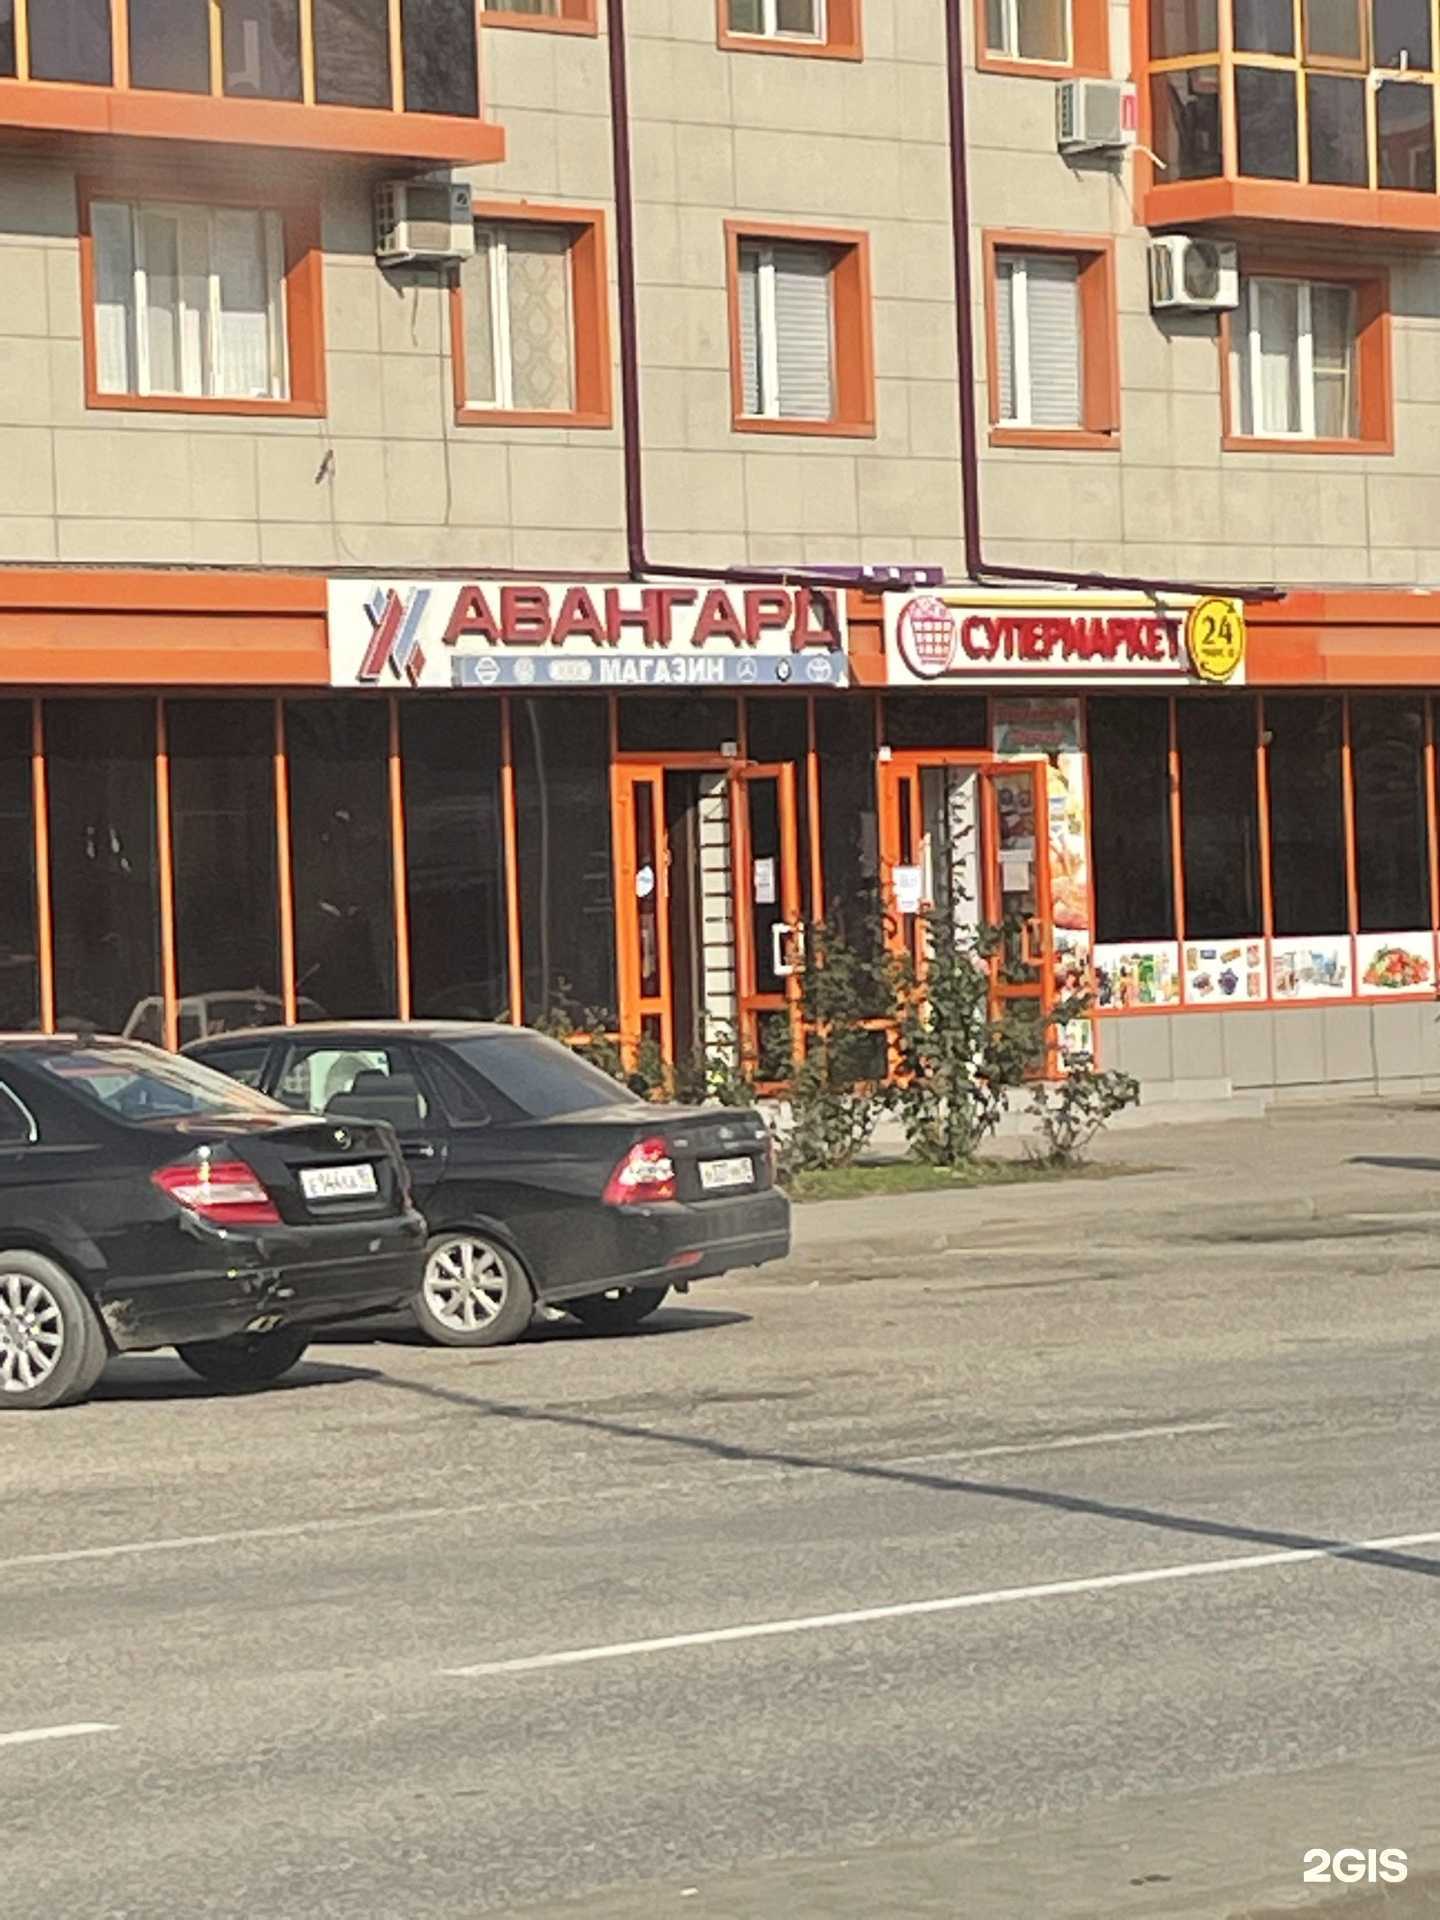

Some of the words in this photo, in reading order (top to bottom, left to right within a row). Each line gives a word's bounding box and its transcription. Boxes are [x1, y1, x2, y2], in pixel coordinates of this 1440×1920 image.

[442, 585, 840, 652] АВАНГАРД
[1202, 615, 1232, 645] 24
[961, 616, 1182, 661] СУПЕРМАРКЕТ
[600, 657, 725, 683] МАГАЗИН
